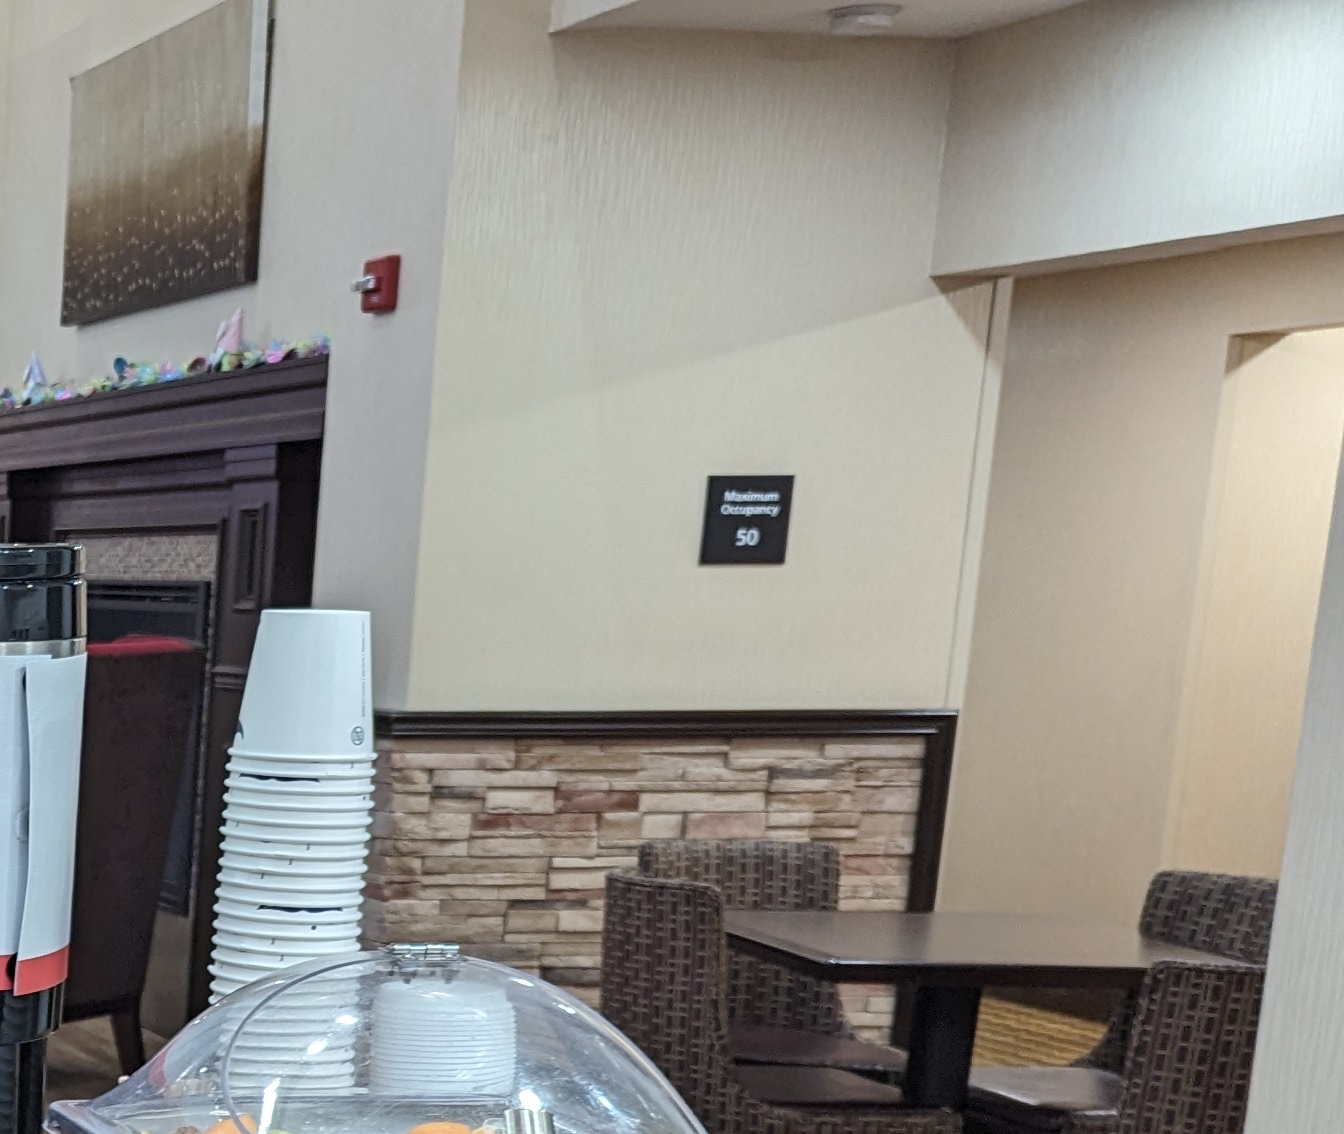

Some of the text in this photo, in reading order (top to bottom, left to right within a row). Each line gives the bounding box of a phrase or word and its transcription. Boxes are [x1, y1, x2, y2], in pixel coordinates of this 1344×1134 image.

[724, 490, 780, 501] Maximum
[720, 504, 780, 517] Occupancy
[735, 527, 760, 547] 50
